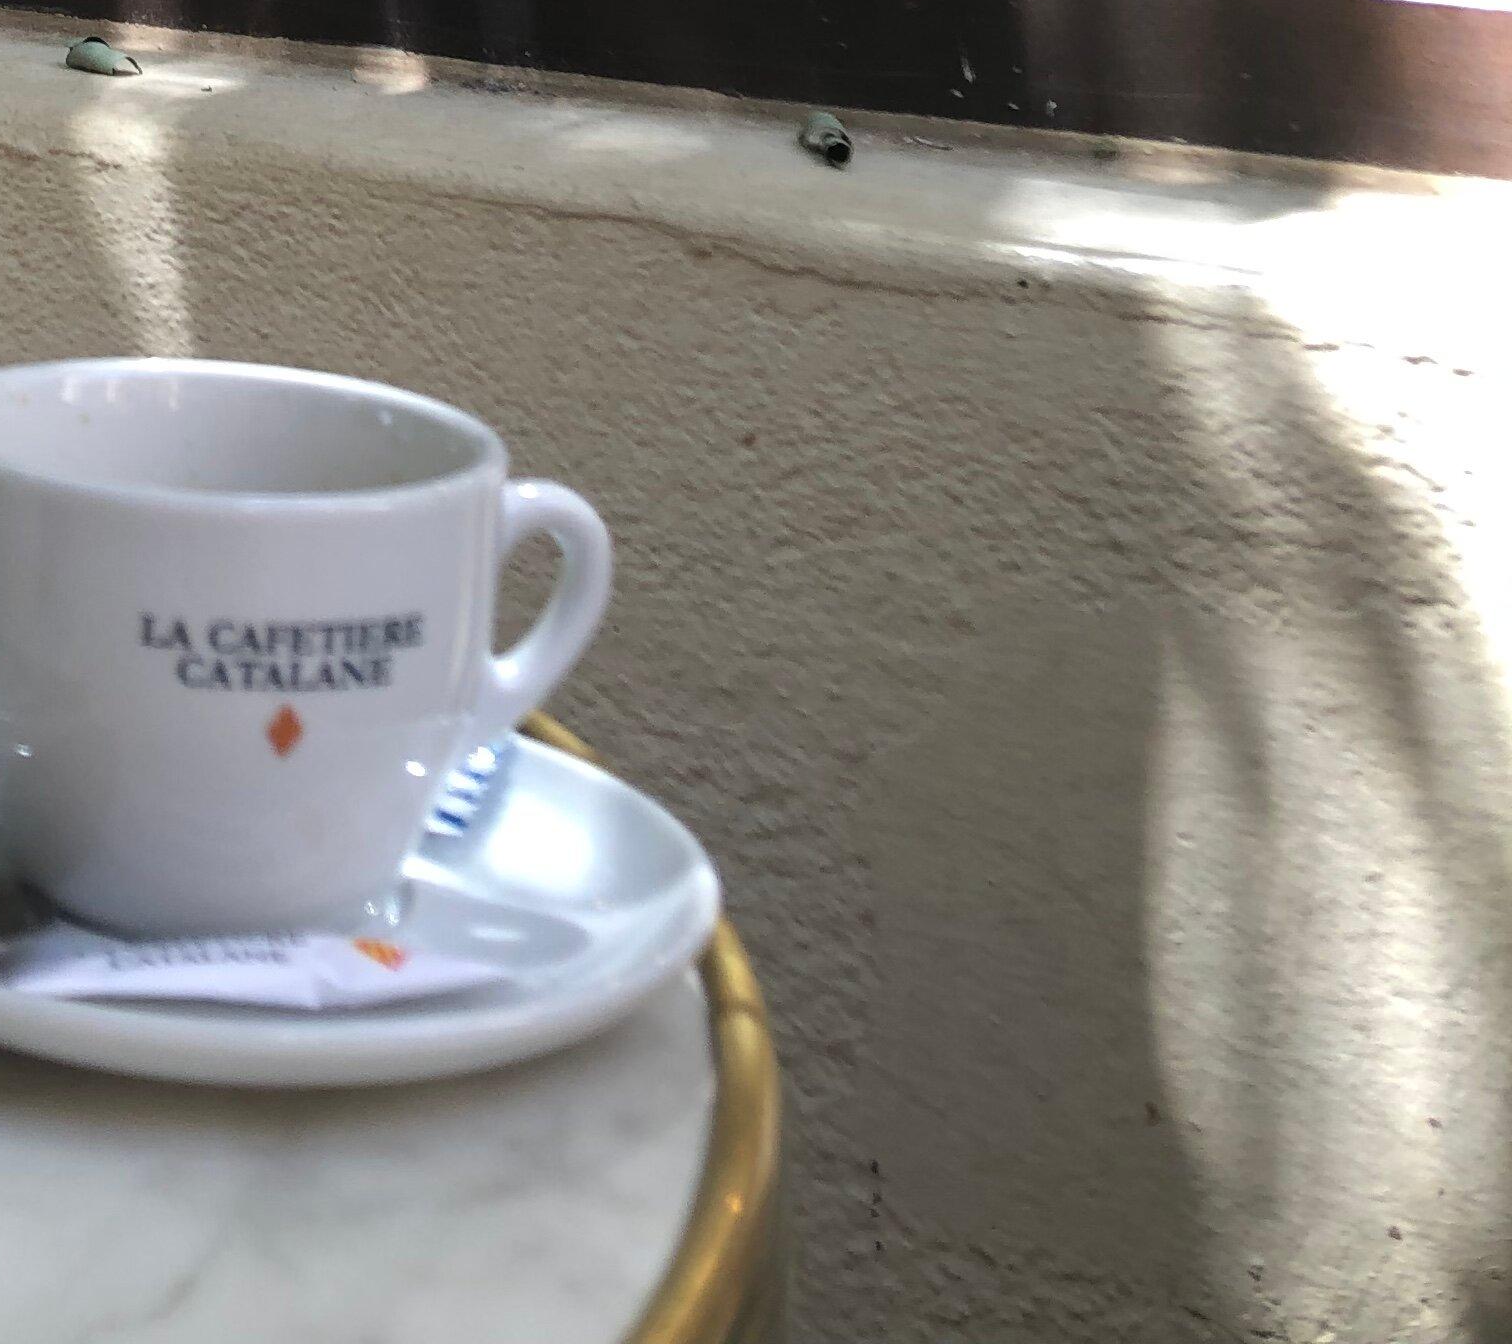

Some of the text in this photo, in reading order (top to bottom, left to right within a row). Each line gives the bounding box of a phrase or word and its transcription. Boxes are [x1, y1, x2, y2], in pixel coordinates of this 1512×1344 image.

[139, 611, 426, 656] LA CAFETIERE
[174, 654, 393, 692] CATALANE
